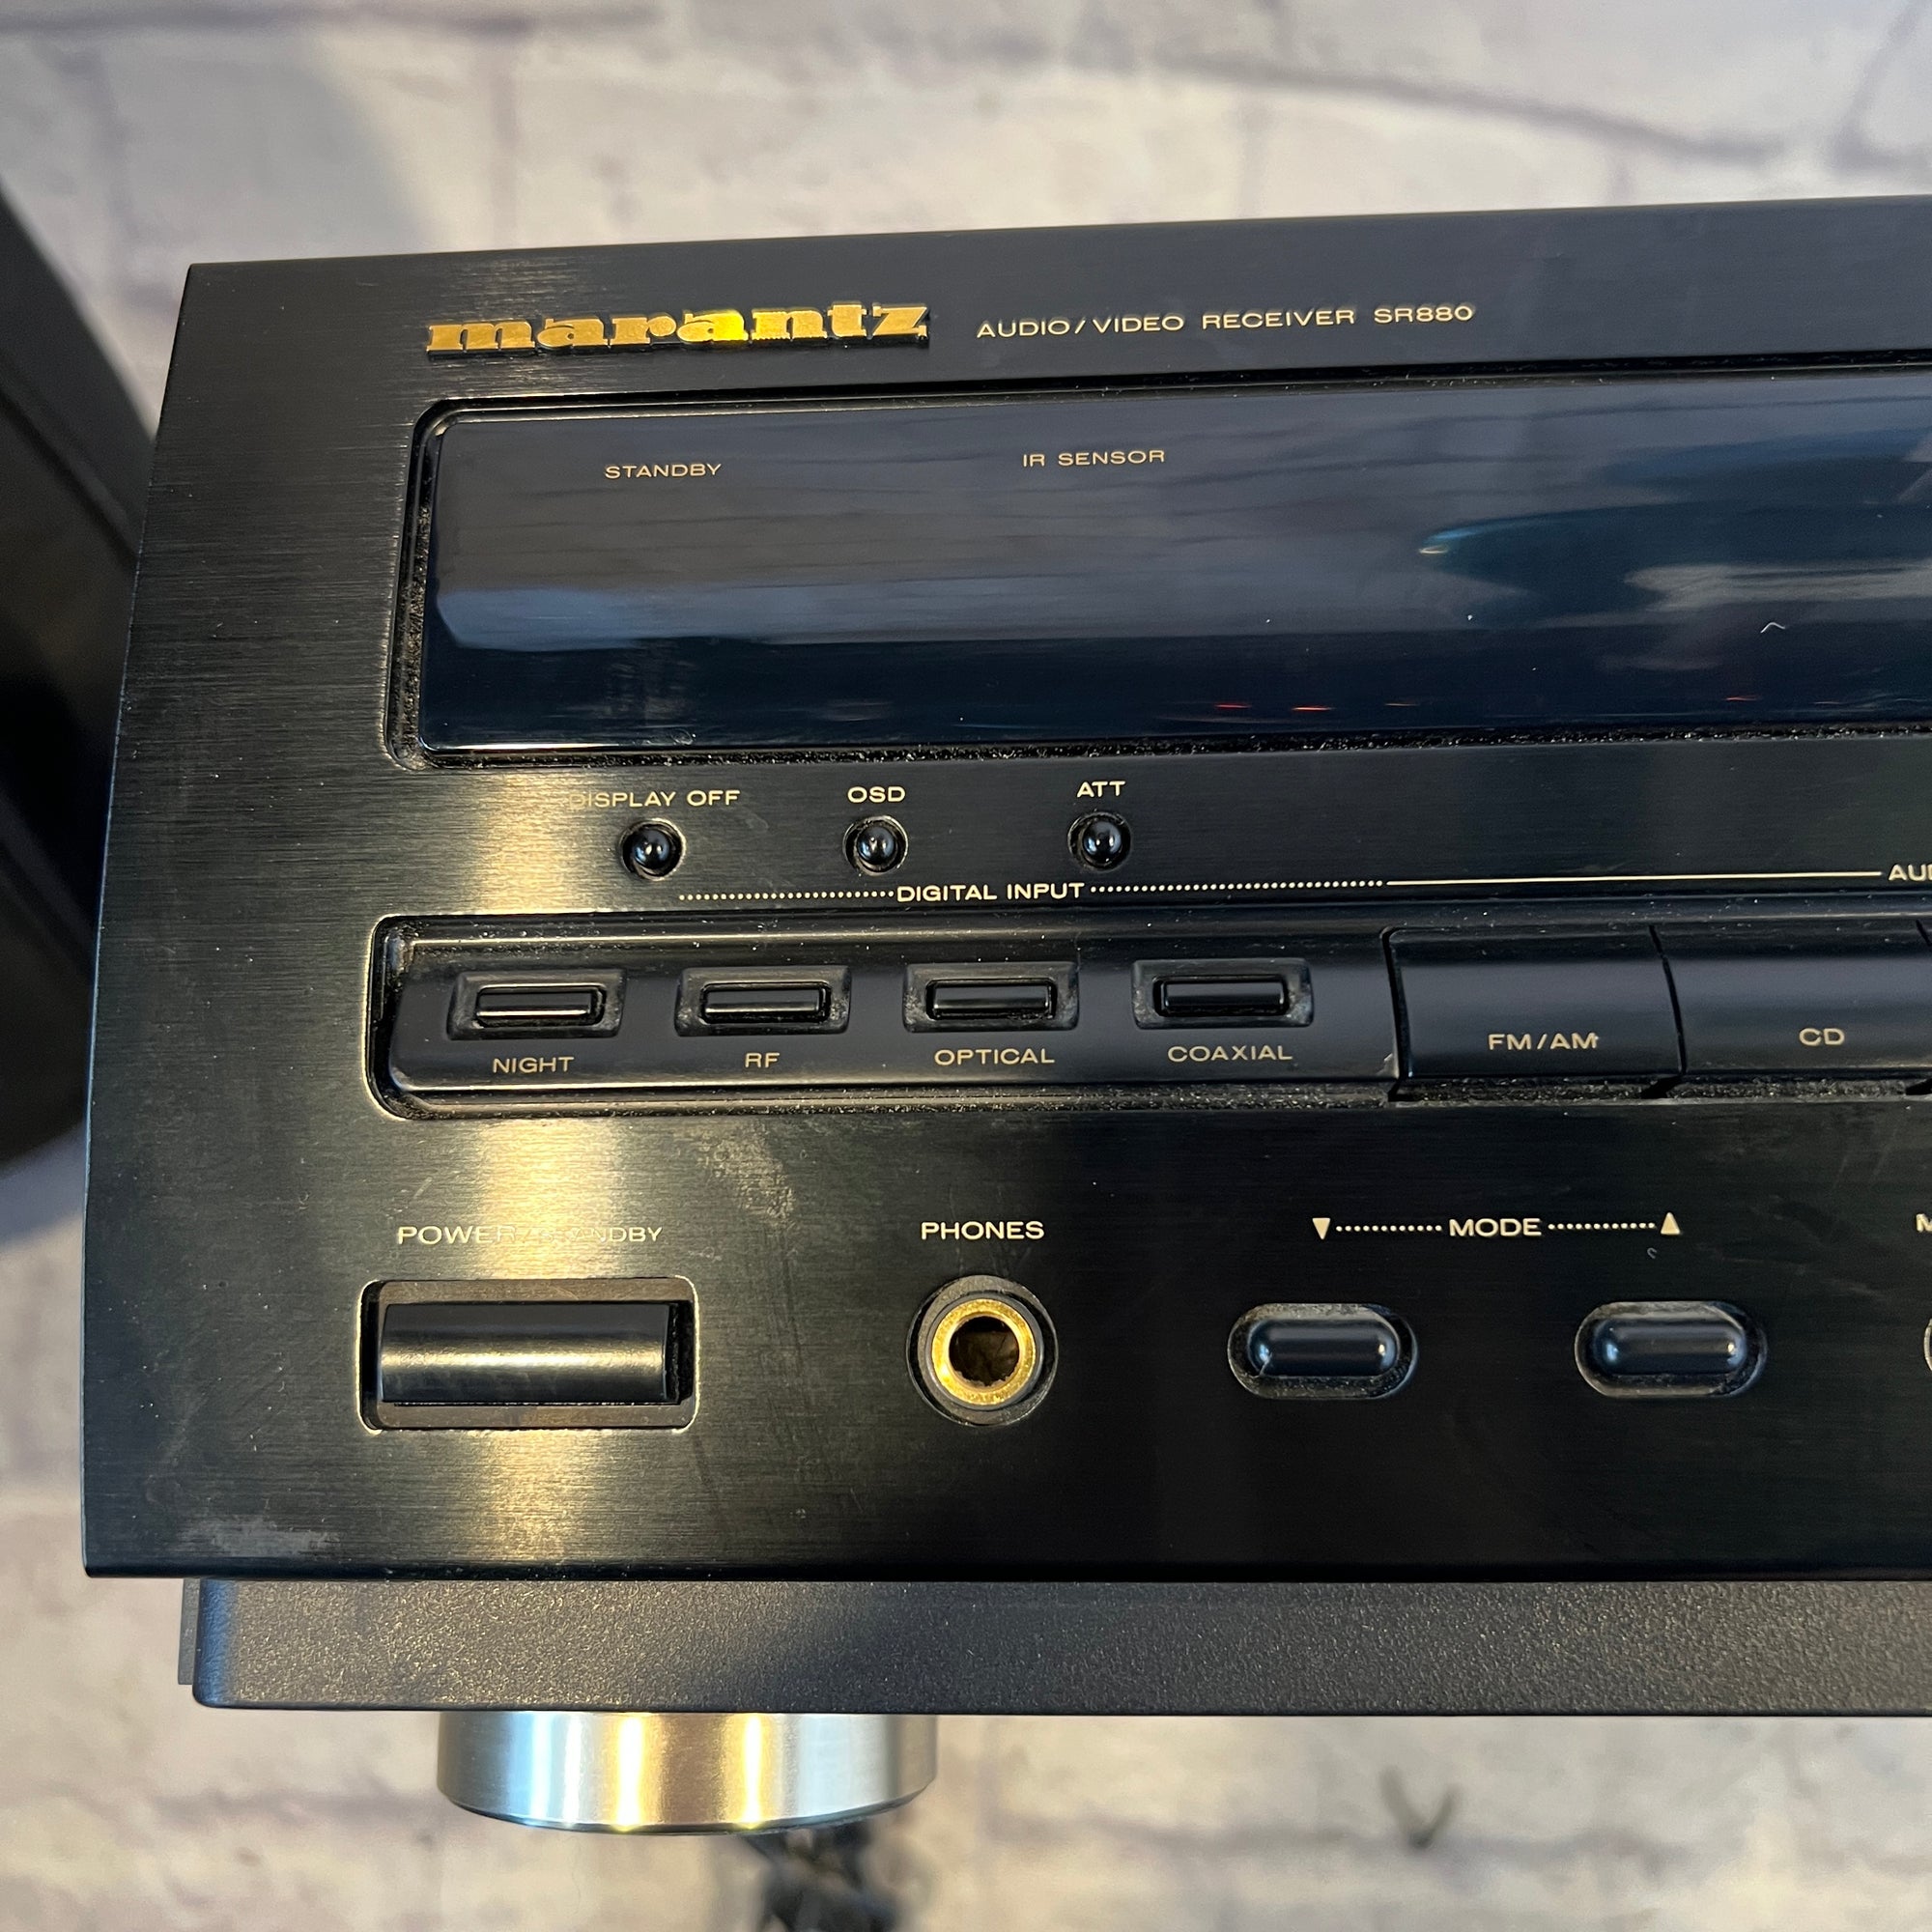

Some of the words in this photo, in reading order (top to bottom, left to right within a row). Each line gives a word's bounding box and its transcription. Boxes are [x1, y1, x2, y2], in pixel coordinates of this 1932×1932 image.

[425, 300, 929, 354] marantz
[976, 313, 1185, 340] AUDIO/VIDEO
[1201, 307, 1356, 331] RECEIVER
[1373, 303, 1476, 325] SR880
[1022, 451, 1046, 469] IR
[1057, 447, 1166, 468] SENSOR
[604, 462, 723, 480] STANDBY
[568, 790, 676, 809] DISPLAY
[685, 789, 741, 807] OFF
[846, 785, 906, 804] OSD
[1076, 780, 1126, 798] ATT
[1888, 863, 1932, 882] AU
[895, 883, 997, 903] DIGITAL
[1006, 881, 1085, 900] INPUT
[1488, 1032, 1600, 1053] FM/AM
[1798, 1027, 1846, 1047] CD
[745, 1051, 781, 1069] RF
[933, 1047, 1056, 1066] OPTICAL
[1167, 1043, 1294, 1064] COAXIAL
[492, 1056, 576, 1074] NIGHT
[396, 1224, 664, 1246] POWER/SANDBY
[920, 1220, 1046, 1241] PHONES
[1448, 1217, 1543, 1238] MODE
